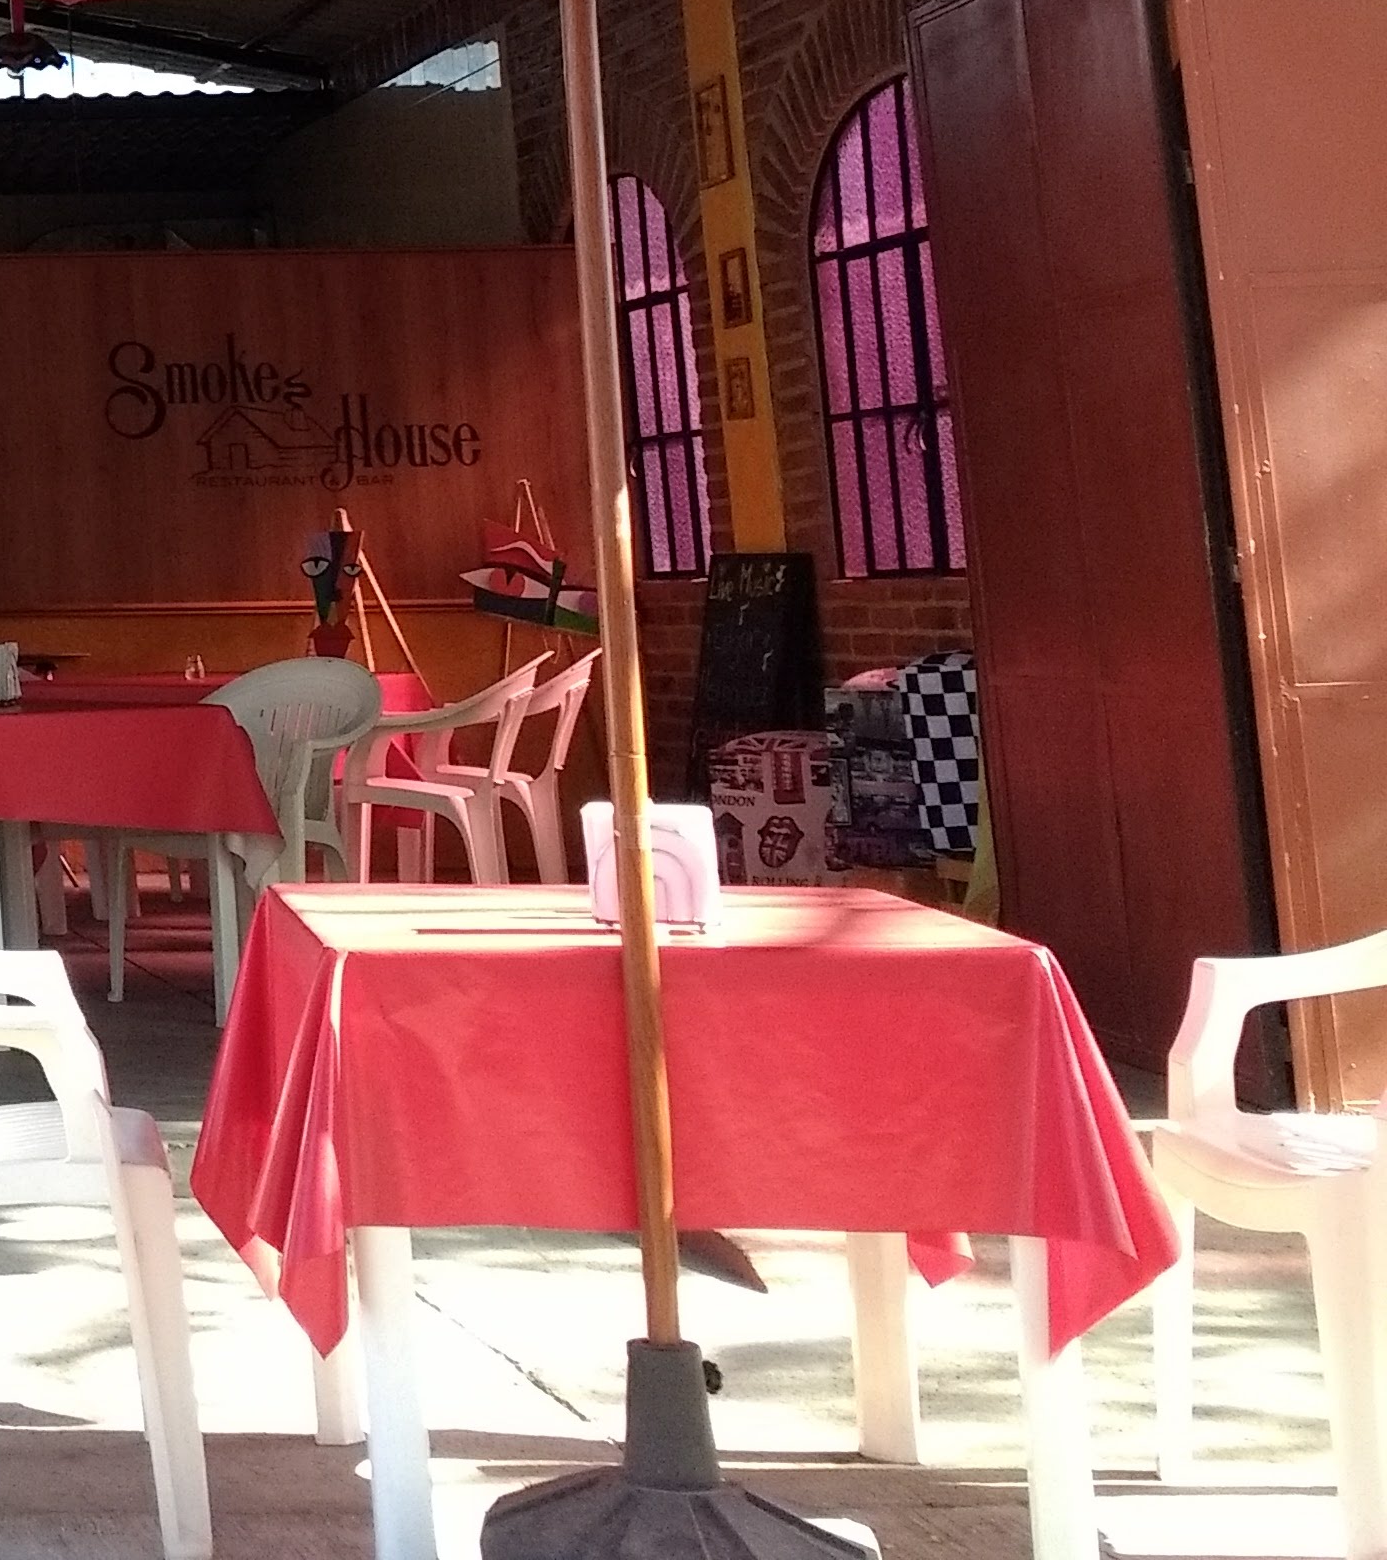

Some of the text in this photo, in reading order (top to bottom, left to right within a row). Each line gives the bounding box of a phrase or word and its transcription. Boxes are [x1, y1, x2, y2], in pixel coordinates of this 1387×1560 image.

[105, 330, 281, 440] Smoke
[321, 393, 481, 493] House
[196, 475, 315, 488] RESTAURANT
[357, 474, 395, 487] BAR
[712, 794, 756, 807] ONDON
